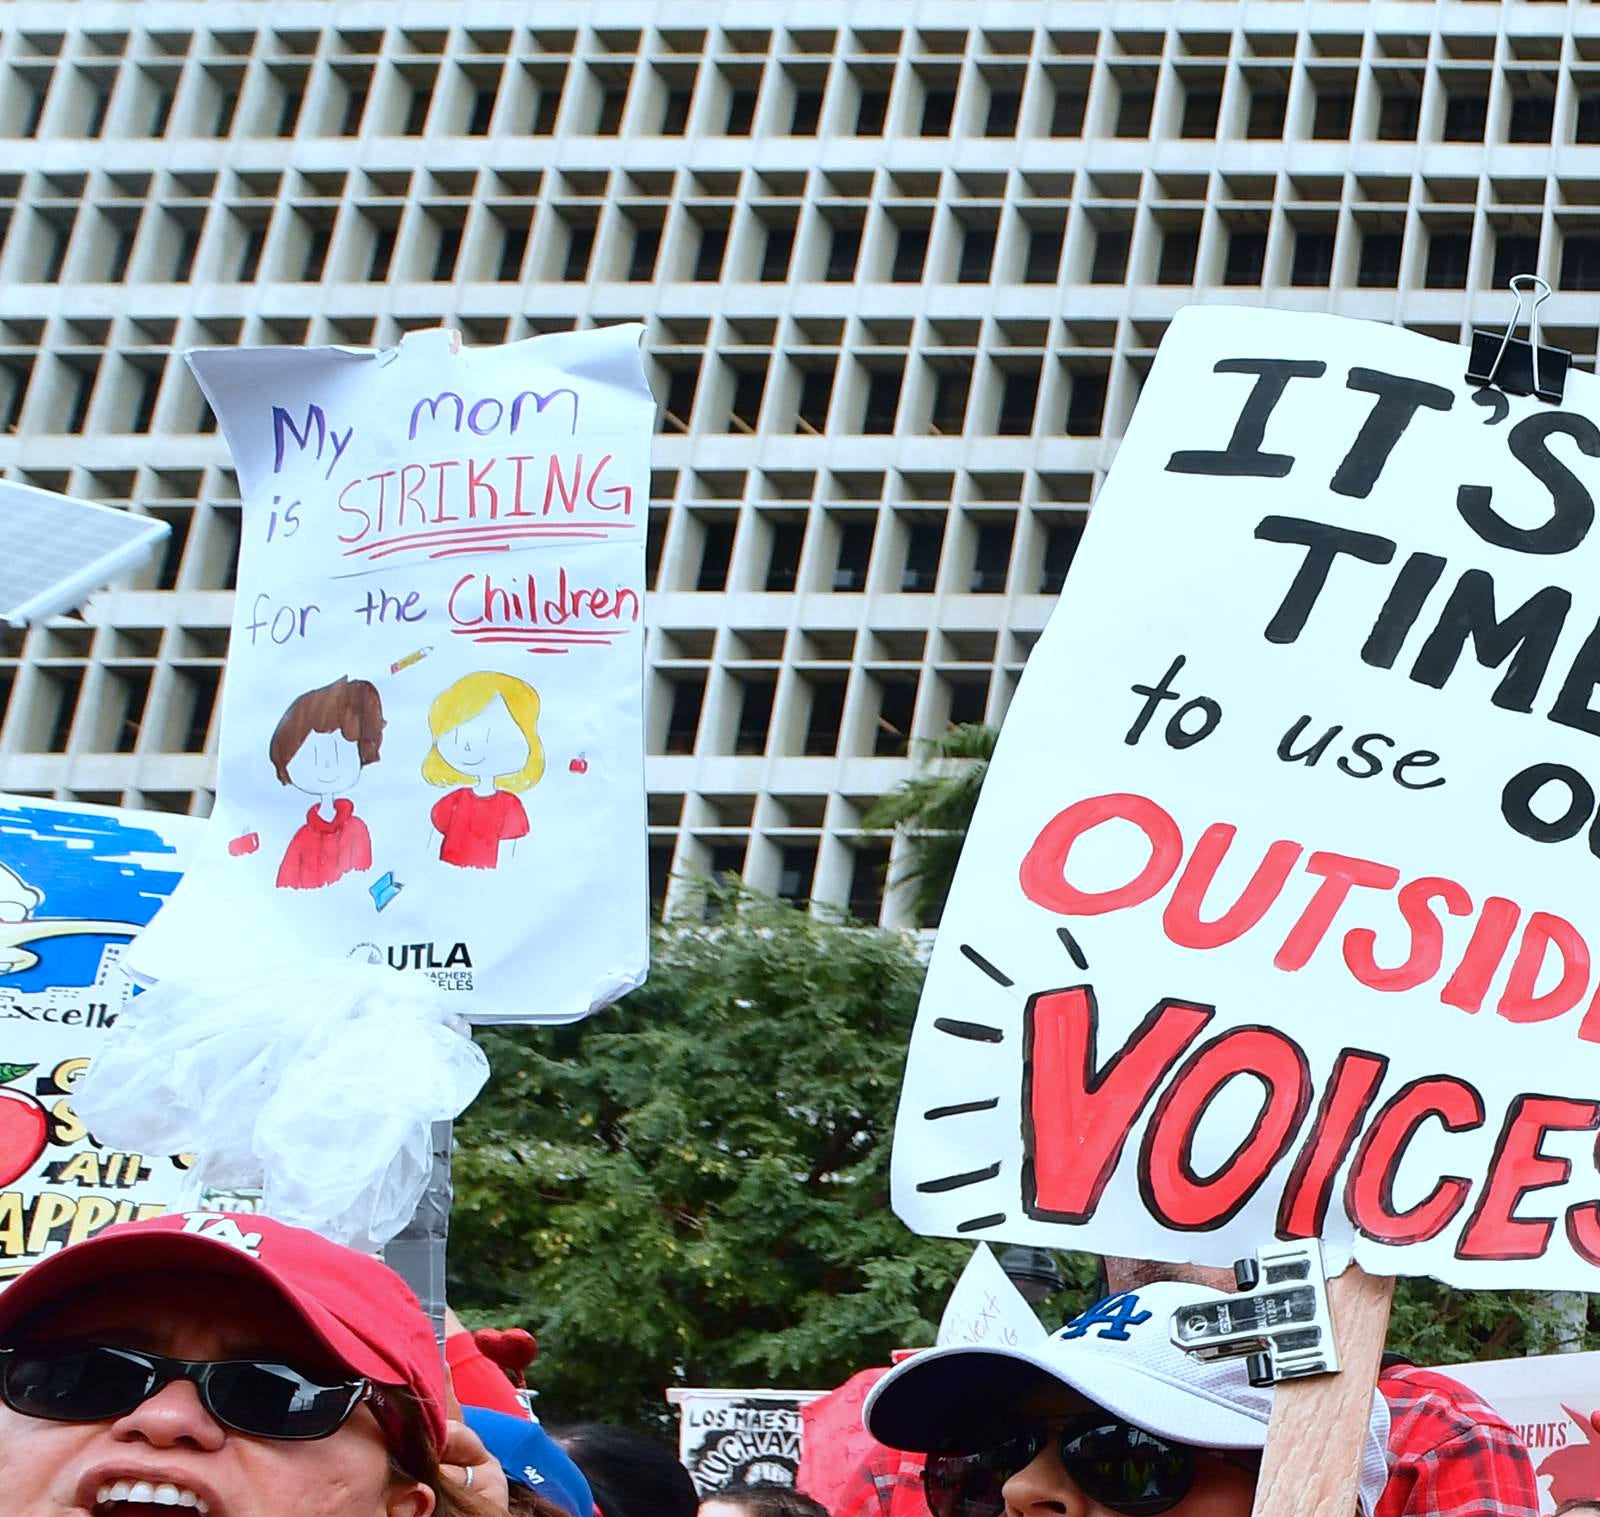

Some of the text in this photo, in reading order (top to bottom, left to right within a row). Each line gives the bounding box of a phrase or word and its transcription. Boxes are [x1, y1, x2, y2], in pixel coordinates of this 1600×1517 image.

[273, 390, 579, 479] My mom
[267, 454, 630, 542] is STRIKING
[246, 566, 638, 645] for the Children
[1131, 654, 1222, 750] to
[1277, 712, 1447, 790] use
[388, 942, 472, 971] UTLA
[690, 1408, 728, 1428] LOS
